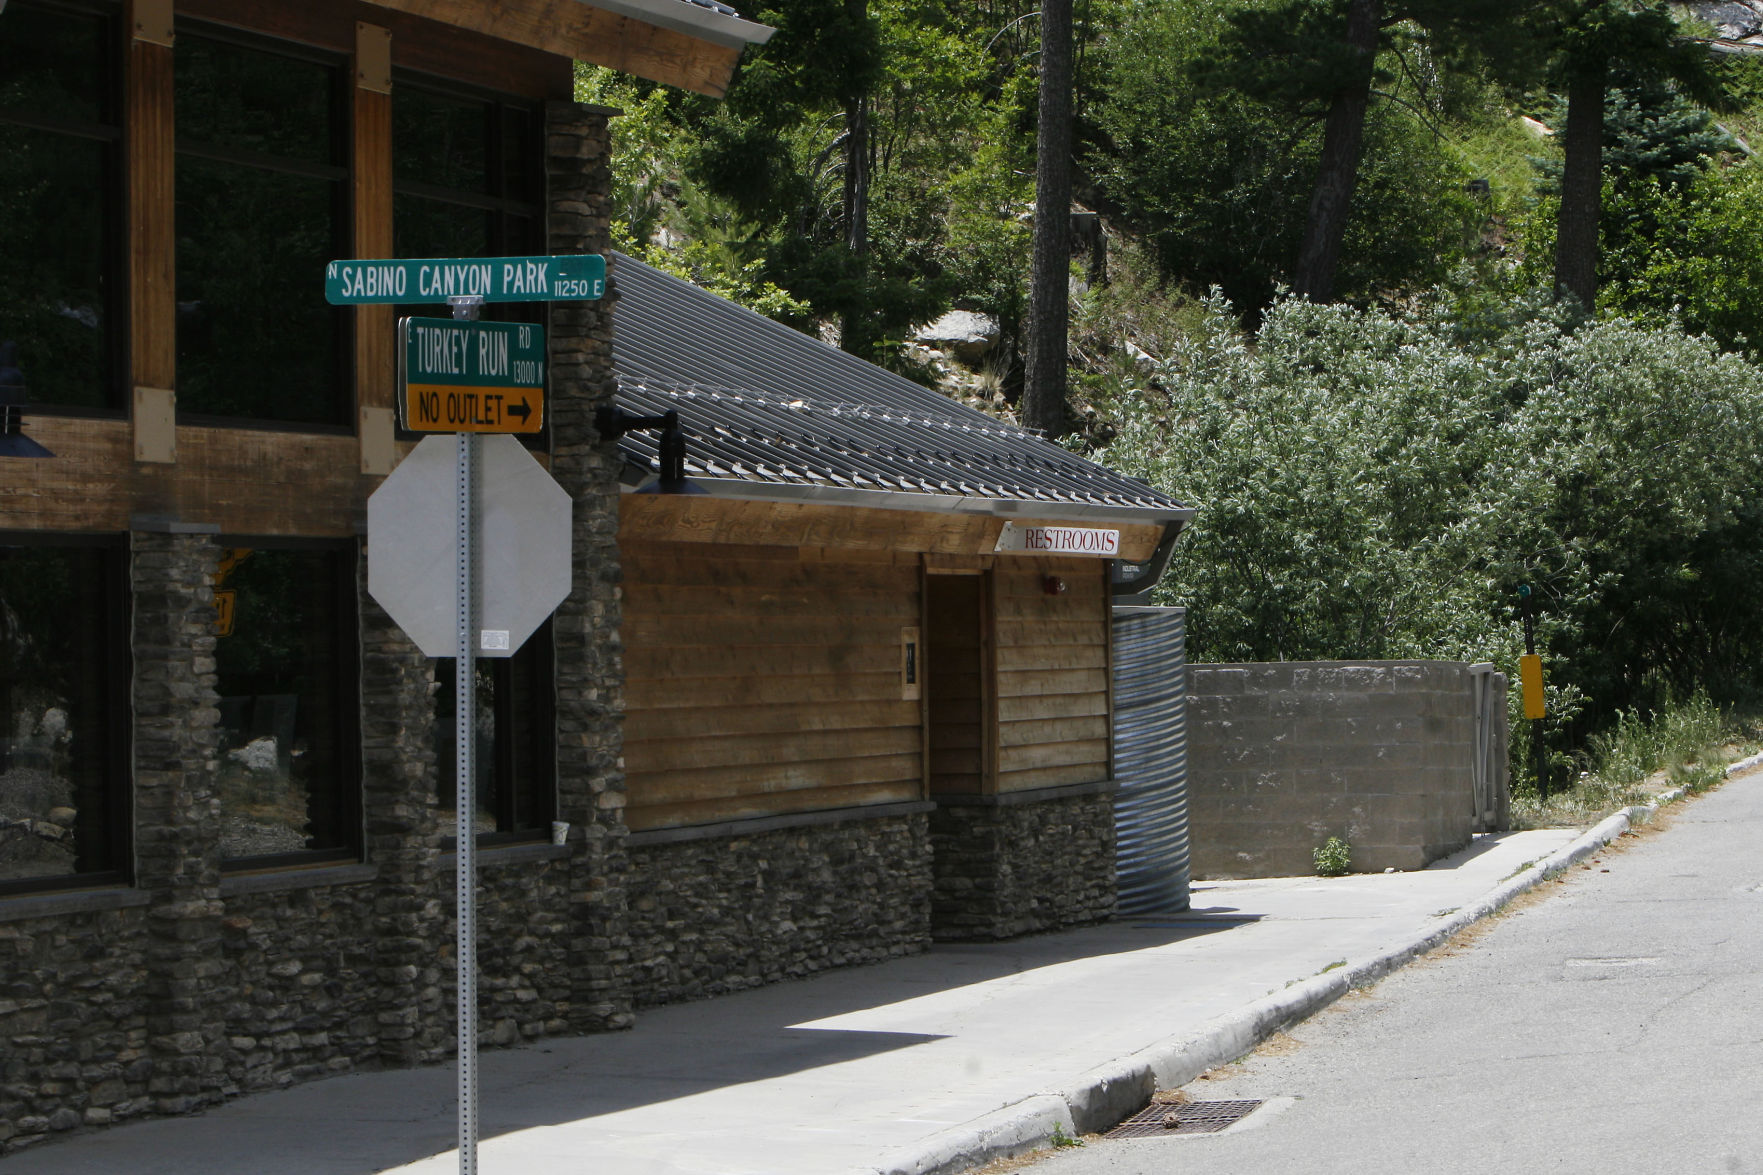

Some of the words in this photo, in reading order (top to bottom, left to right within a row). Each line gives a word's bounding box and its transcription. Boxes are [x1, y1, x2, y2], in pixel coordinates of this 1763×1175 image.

[329, 264, 338, 279] N
[342, 266, 407, 297] SABINO
[419, 265, 491, 295] CANYON
[503, 263, 548, 294] PARK
[554, 280, 588, 297] 11250
[593, 280, 602, 296] E
[417, 327, 469, 375] TURKEY
[479, 331, 508, 376] RUN
[519, 326, 531, 349] RD
[513, 361, 536, 384] 13000
[419, 391, 440, 423] NO
[447, 392, 504, 425] OUTLET
[1025, 529, 1116, 552] RESTROOMS
